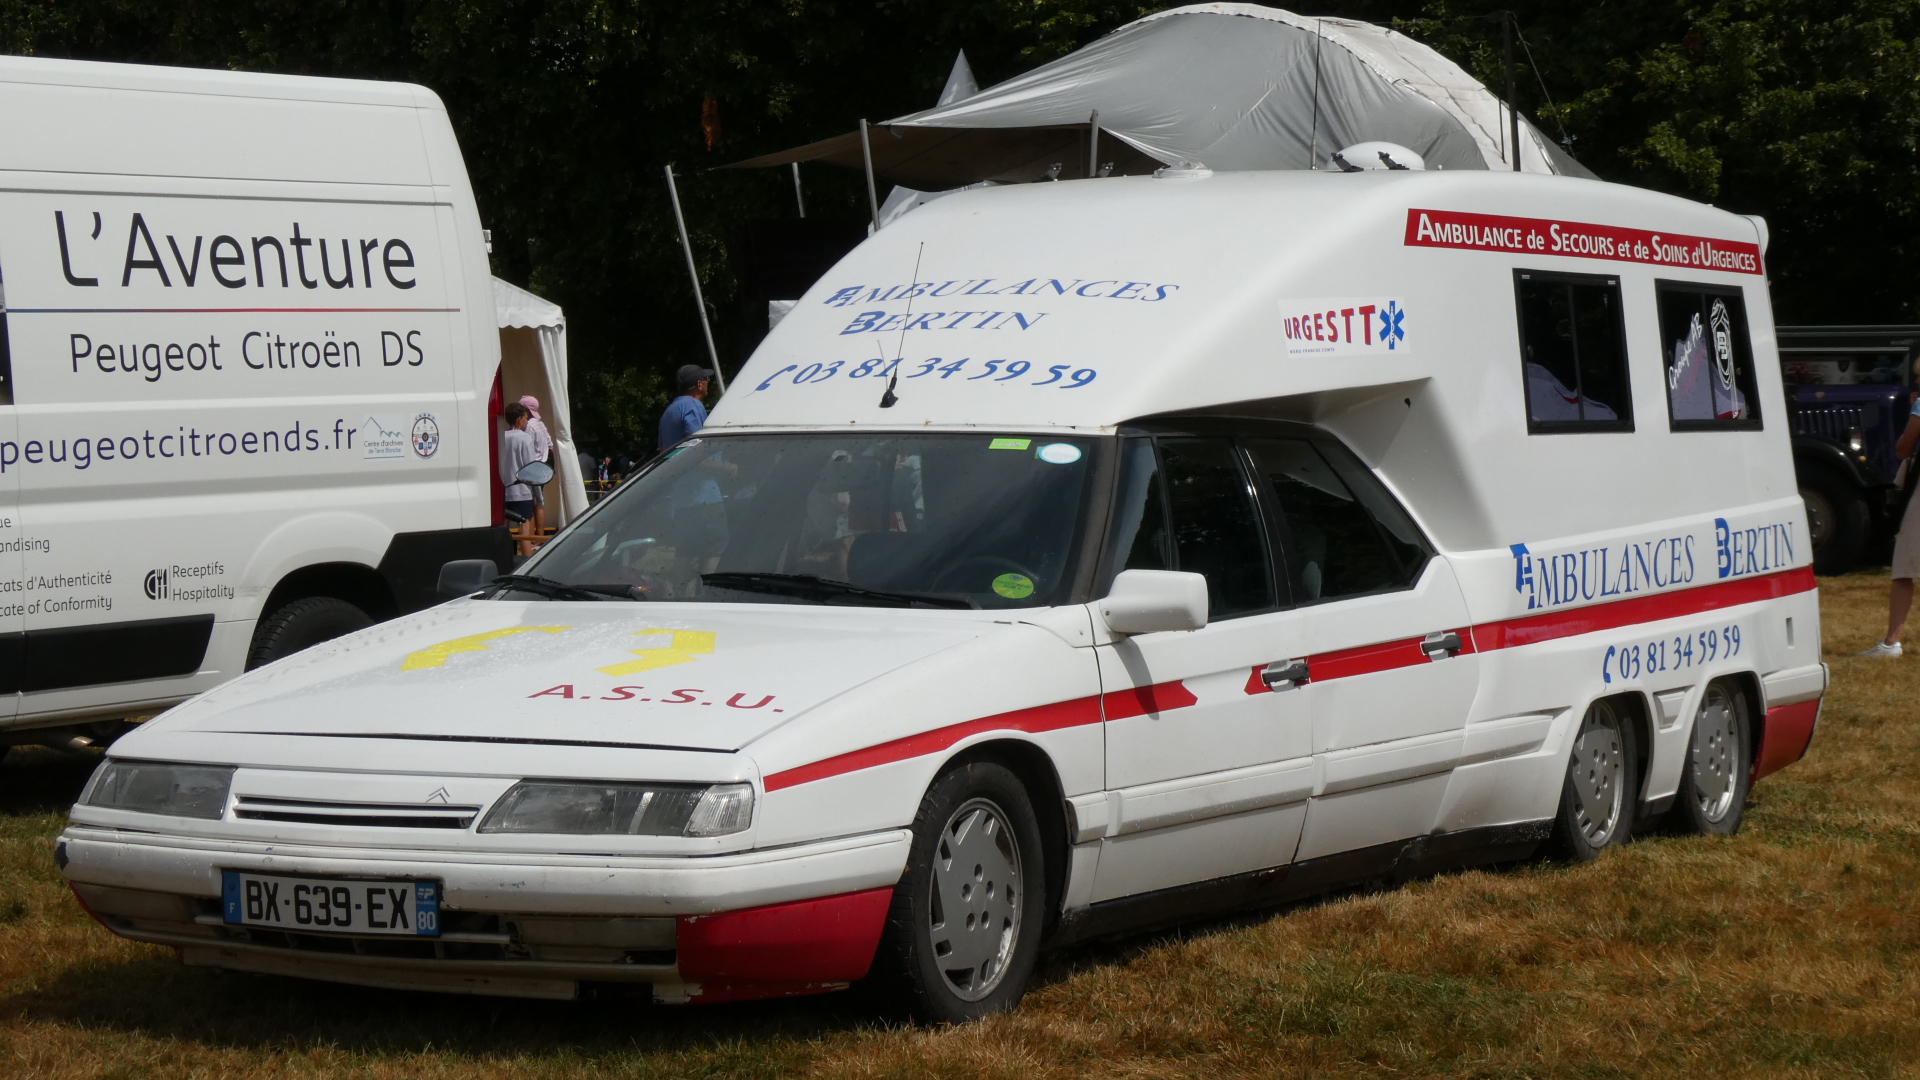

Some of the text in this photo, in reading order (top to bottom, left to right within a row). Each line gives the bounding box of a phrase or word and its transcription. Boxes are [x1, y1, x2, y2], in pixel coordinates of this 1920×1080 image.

[54, 210, 417, 290] L'Aventure
[1417, 213, 1523, 248] AMBULANCE
[1526, 229, 1545, 250] de
[1549, 223, 1615, 256] SECOURS
[1617, 240, 1631, 257] et
[1633, 239, 1650, 259] de
[1651, 235, 1690, 264] SOINS
[823, 278, 1180, 308] AMBULANCES
[838, 310, 1049, 336] BERTIN
[1284, 304, 1376, 345] URGESTT
[70, 329, 424, 383] Peugeot Citroën DS
[792, 357, 1098, 389] 03 81 34 59 59
[0, 419, 357, 474] peugeotcitroends.fr
[27, 569, 112, 591] d'Authenticité
[172, 561, 225, 579] Receptifs
[1509, 517, 1794, 610] AMBULANCES BERTIN
[28, 599, 41, 615] of
[44, 595, 112, 612] Conformity
[172, 584, 235, 603] Hospitality
[1620, 625, 1741, 679] 03 81 34 59 59
[526, 684, 785, 713] A.S.S.U.
[229, 902, 236, 914] F
[246, 879, 410, 930] BX-639-EX
[417, 910, 436, 931] 80
